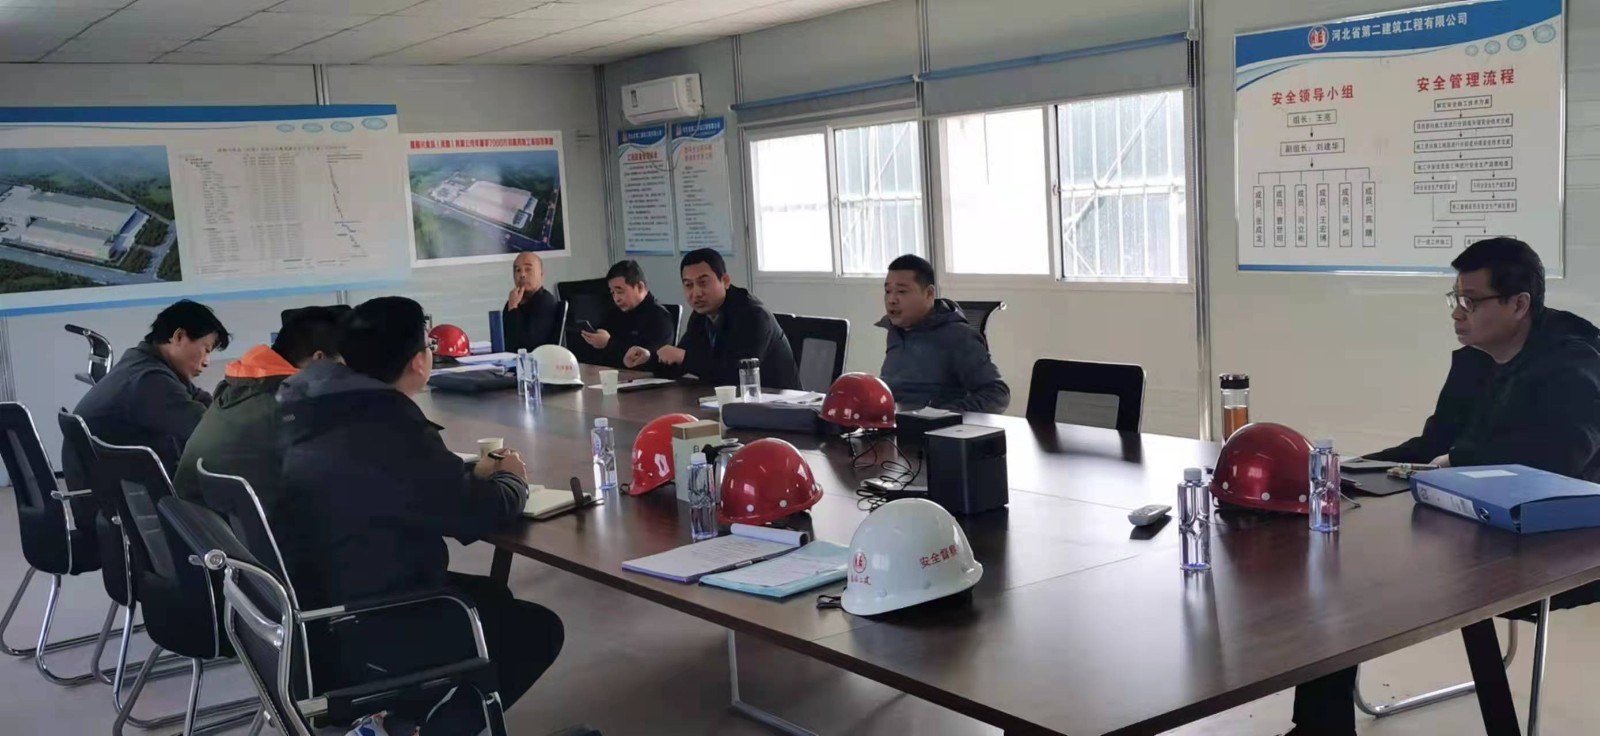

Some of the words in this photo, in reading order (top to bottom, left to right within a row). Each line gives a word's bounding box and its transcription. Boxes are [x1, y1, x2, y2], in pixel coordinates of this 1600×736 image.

[1332, 12, 1467, 42] 河北省第二建筑工程有限公司
[1416, 68, 1514, 92] 安全管理流程
[1271, 84, 1354, 106] 安全领导小组
